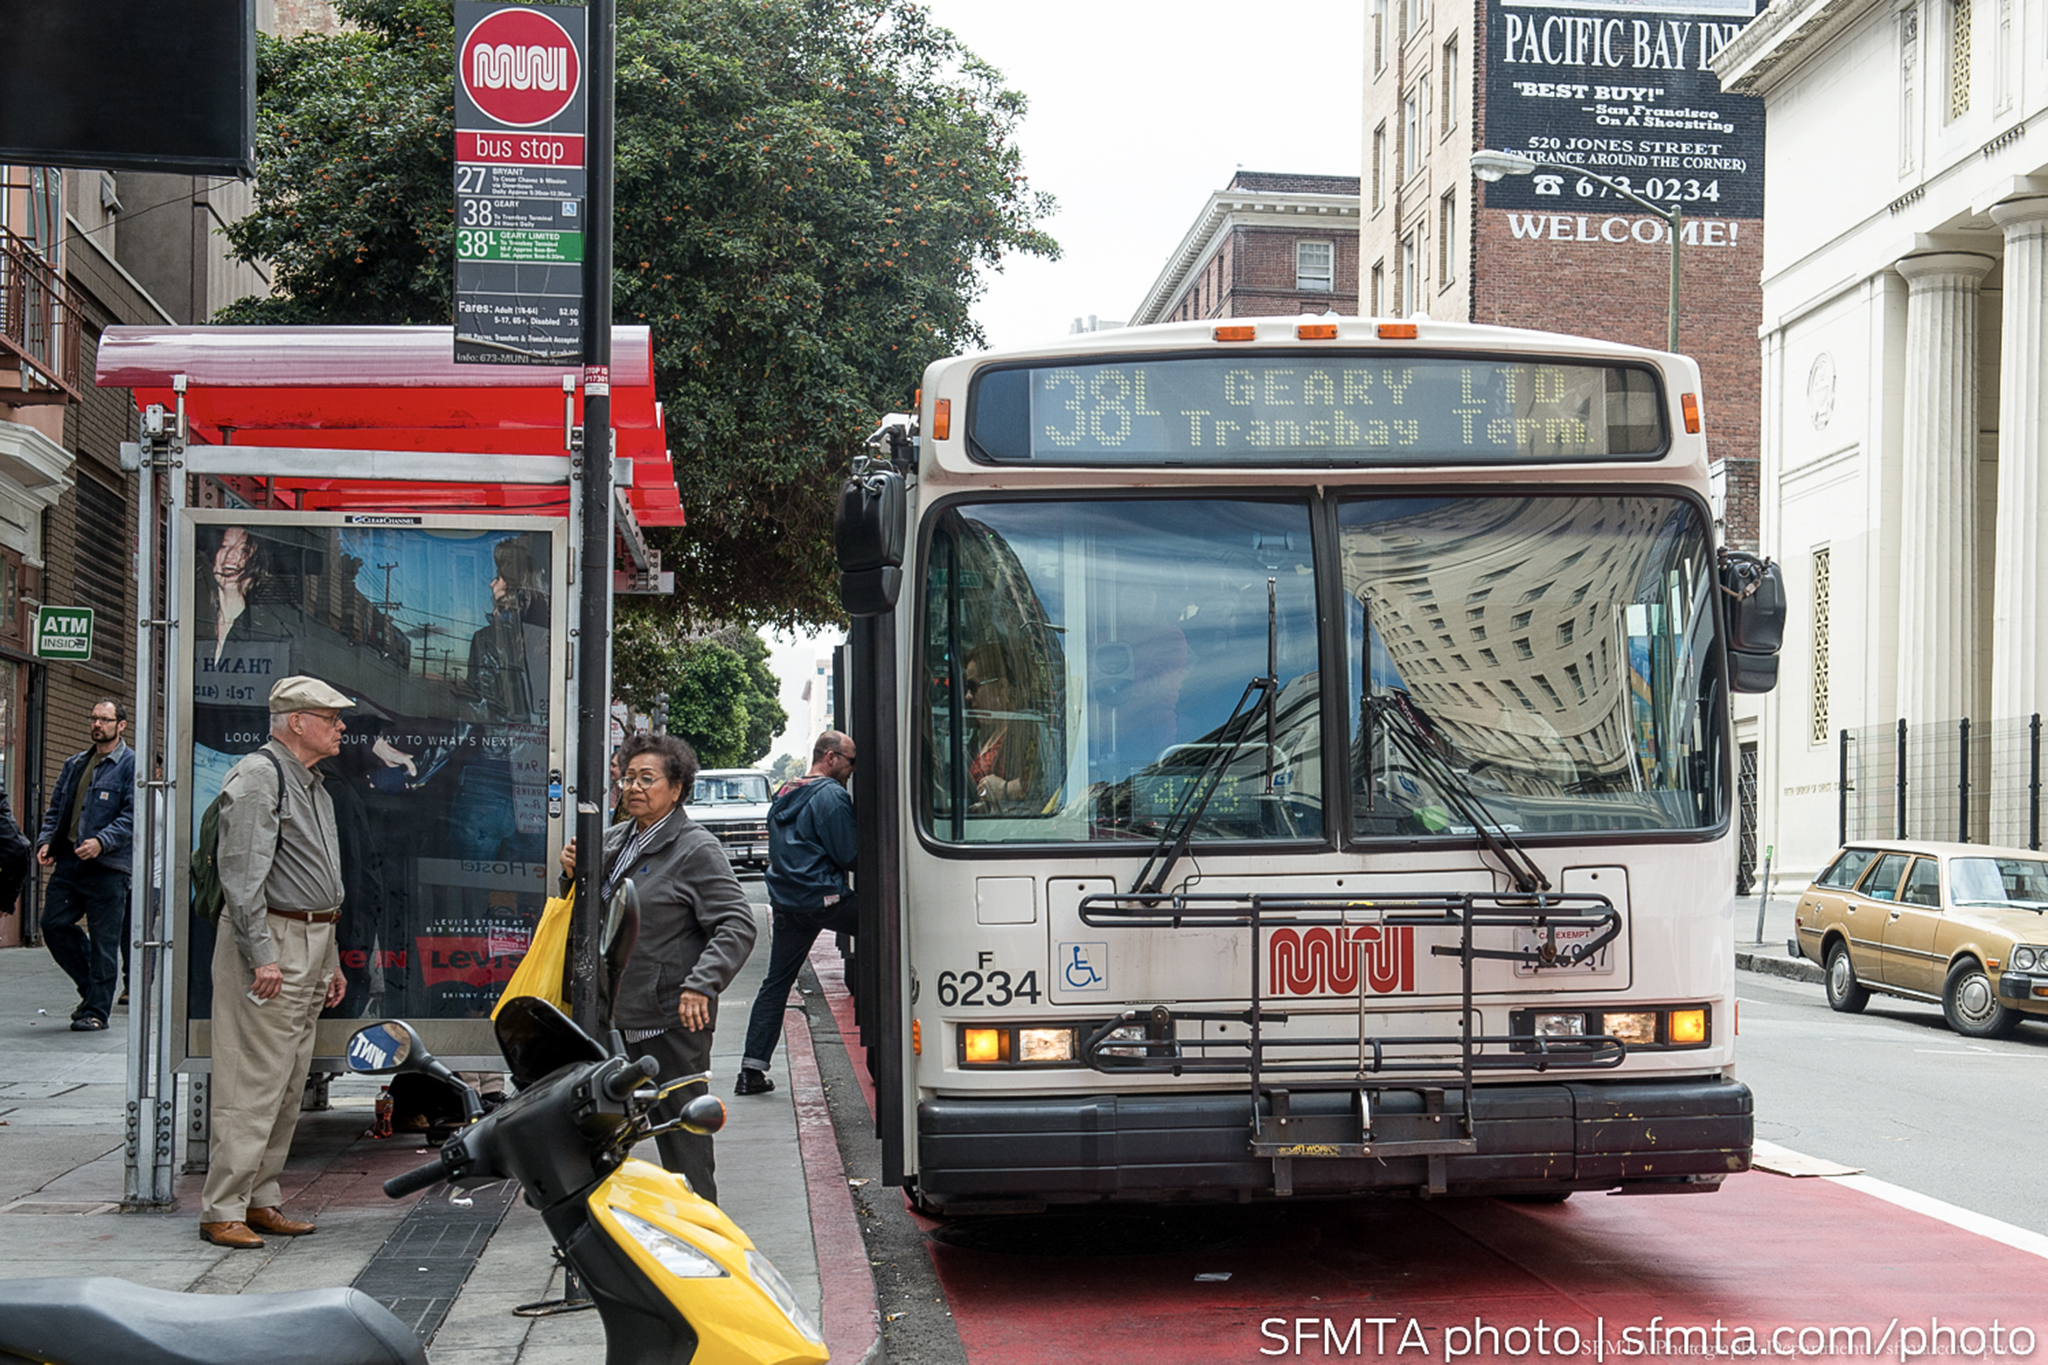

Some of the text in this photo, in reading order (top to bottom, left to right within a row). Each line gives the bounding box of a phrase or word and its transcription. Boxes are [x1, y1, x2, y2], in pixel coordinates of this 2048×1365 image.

[1503, 13, 1748, 71] PACIFIC BAY IN
[473, 43, 567, 92] MUNI
[1512, 81, 1664, 102] "BEST BUY!"
[1633, 105, 1719, 120] Francisco
[1596, 115, 1735, 134] On A Shoestring
[476, 133, 564, 165] bus stop
[1528, 136, 1722, 156] 520 JONES STREET
[492, 168, 524, 176] BRYANT
[1588, 153, 1648, 167] AROUND
[1650, 155, 1680, 168] THE
[1682, 156, 1747, 174] CORNER)
[457, 167, 486, 193] 27
[463, 200, 492, 226] 38
[494, 200, 519, 208] GEARY
[500, 231, 560, 240] GEARY LIMITED
[1507, 213, 1739, 247] WELCOME!
[458, 301, 493, 314] Fares:
[559, 308, 579, 316] $2.00
[530, 317, 560, 326] Disabled
[457, 353, 479, 362] Info:
[480, 353, 529, 363] 673-MUNI
[1046, 368, 1565, 446] 38L GEARY LTD
[1180, 408, 1595, 446] Transbay Term.
[43, 616, 88, 634] ATM
[225, 732, 261, 743] LOOK
[342, 735, 368, 744] OUR
[374, 735, 400, 745] WAY
[406, 735, 423, 745] TO
[428, 736, 476, 747] WHAT'S
[1556, 930, 1590, 939] EXEMPT
[978, 951, 993, 970] F
[1269, 926, 1414, 995] MUNI
[937, 970, 1042, 1007] 6234
